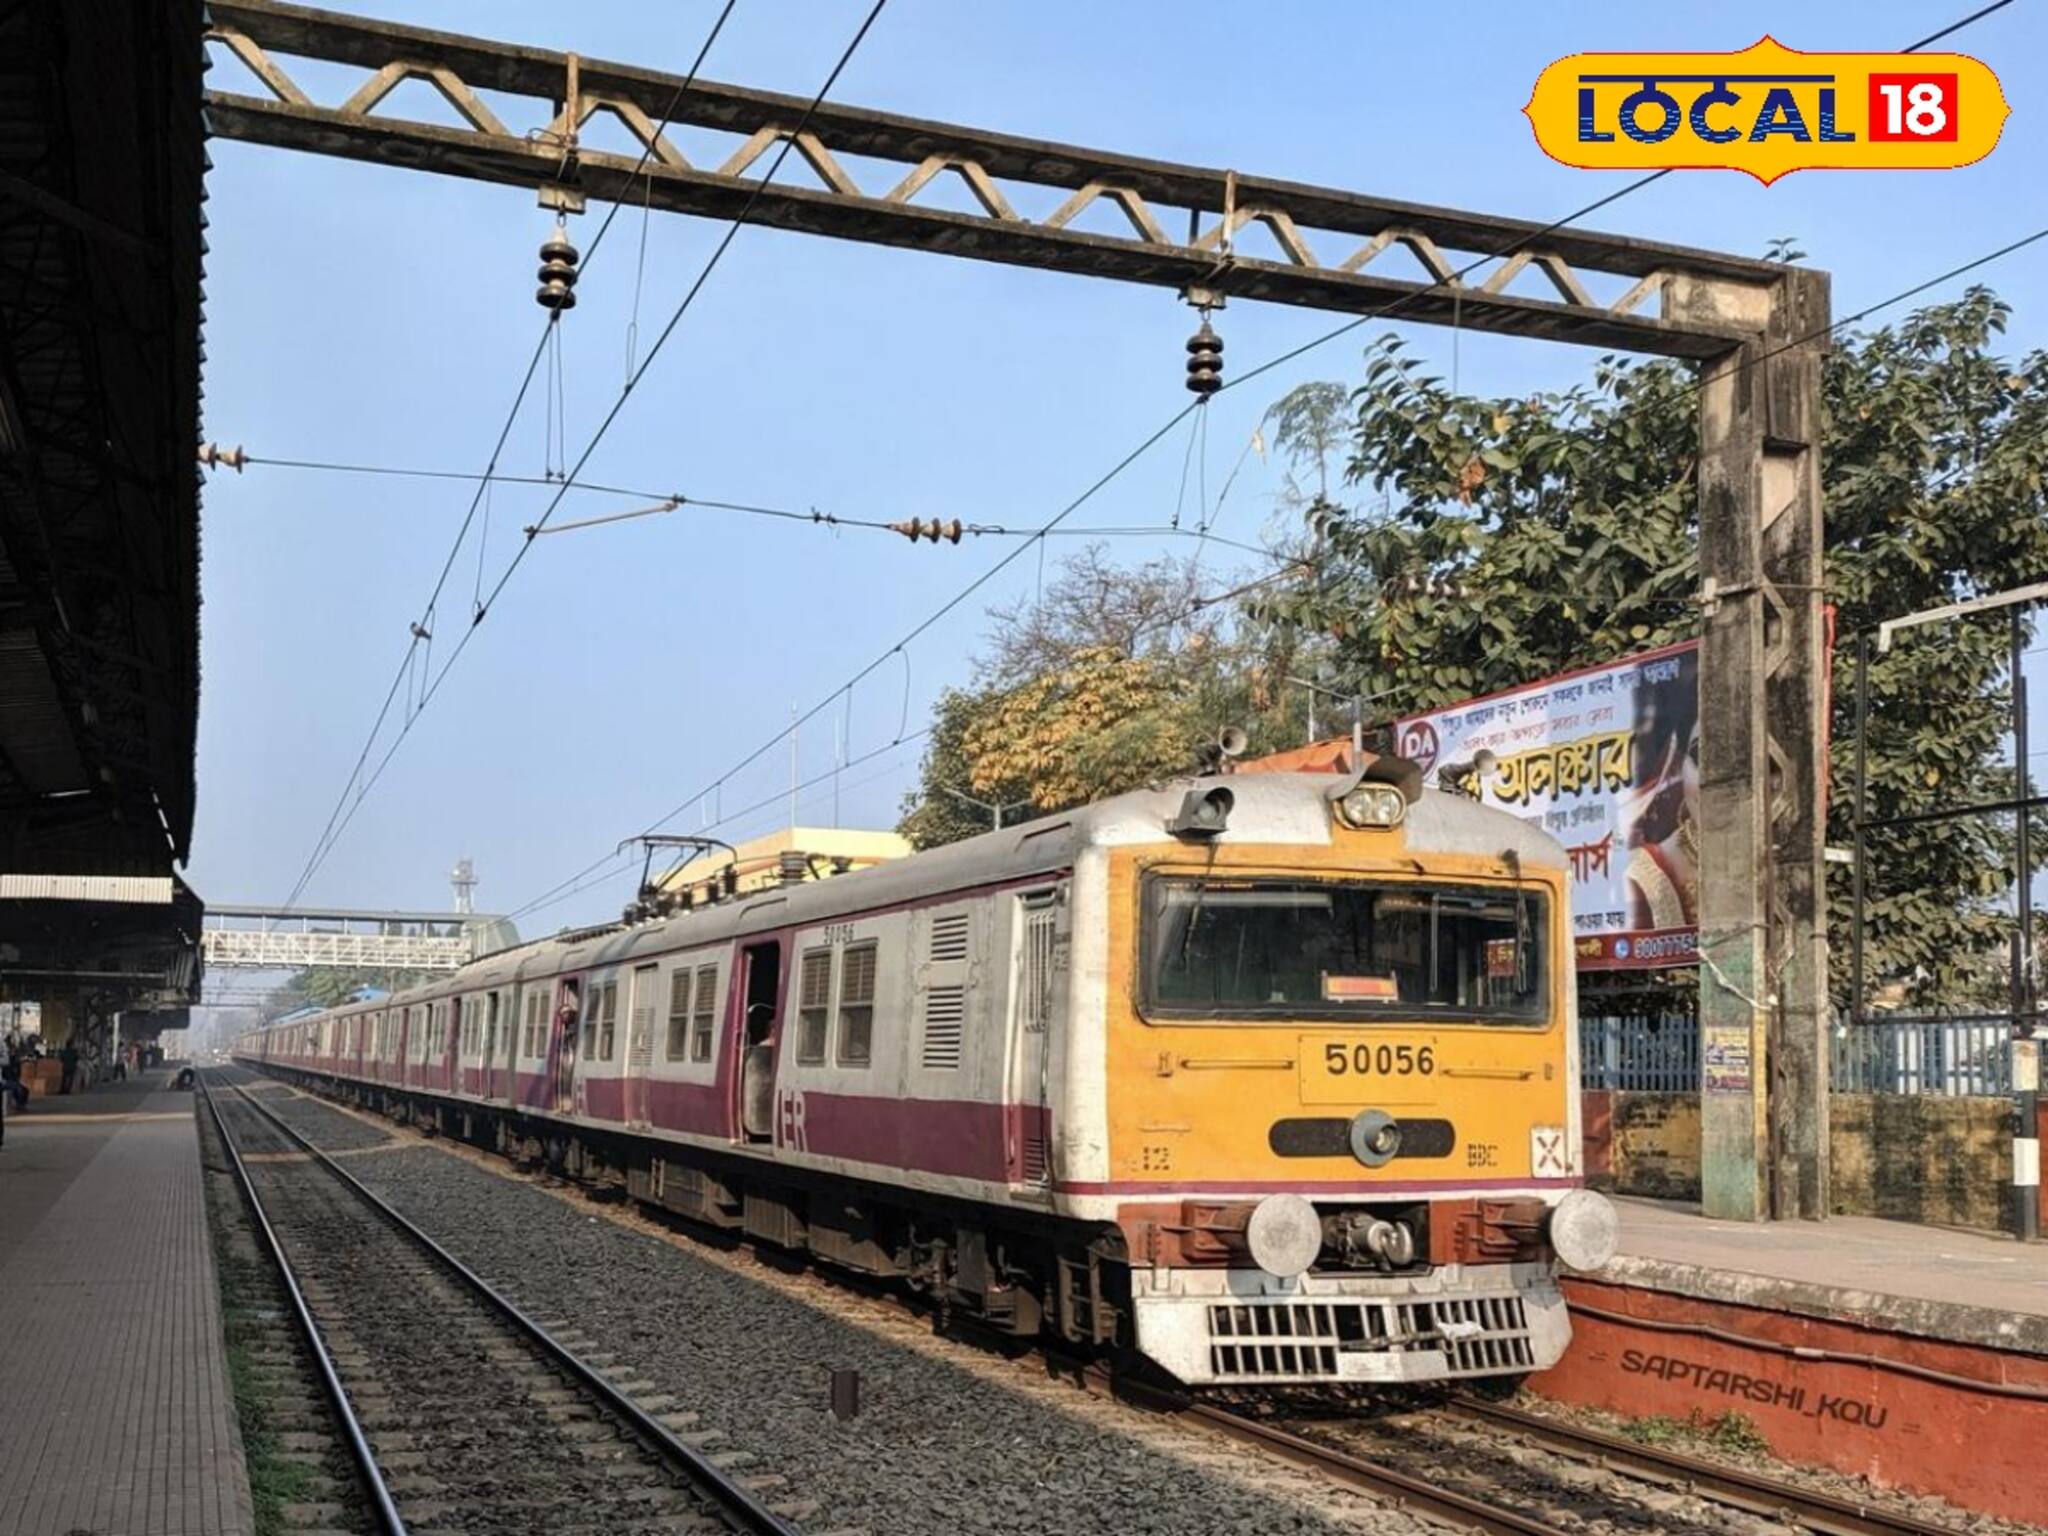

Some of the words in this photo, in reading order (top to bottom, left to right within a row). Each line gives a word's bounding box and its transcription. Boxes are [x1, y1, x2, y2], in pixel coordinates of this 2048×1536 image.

[1406, 729, 1436, 758] DA
[1492, 730, 1637, 807] অলঙ্কার
[1325, 1043, 1434, 1076] 50056
